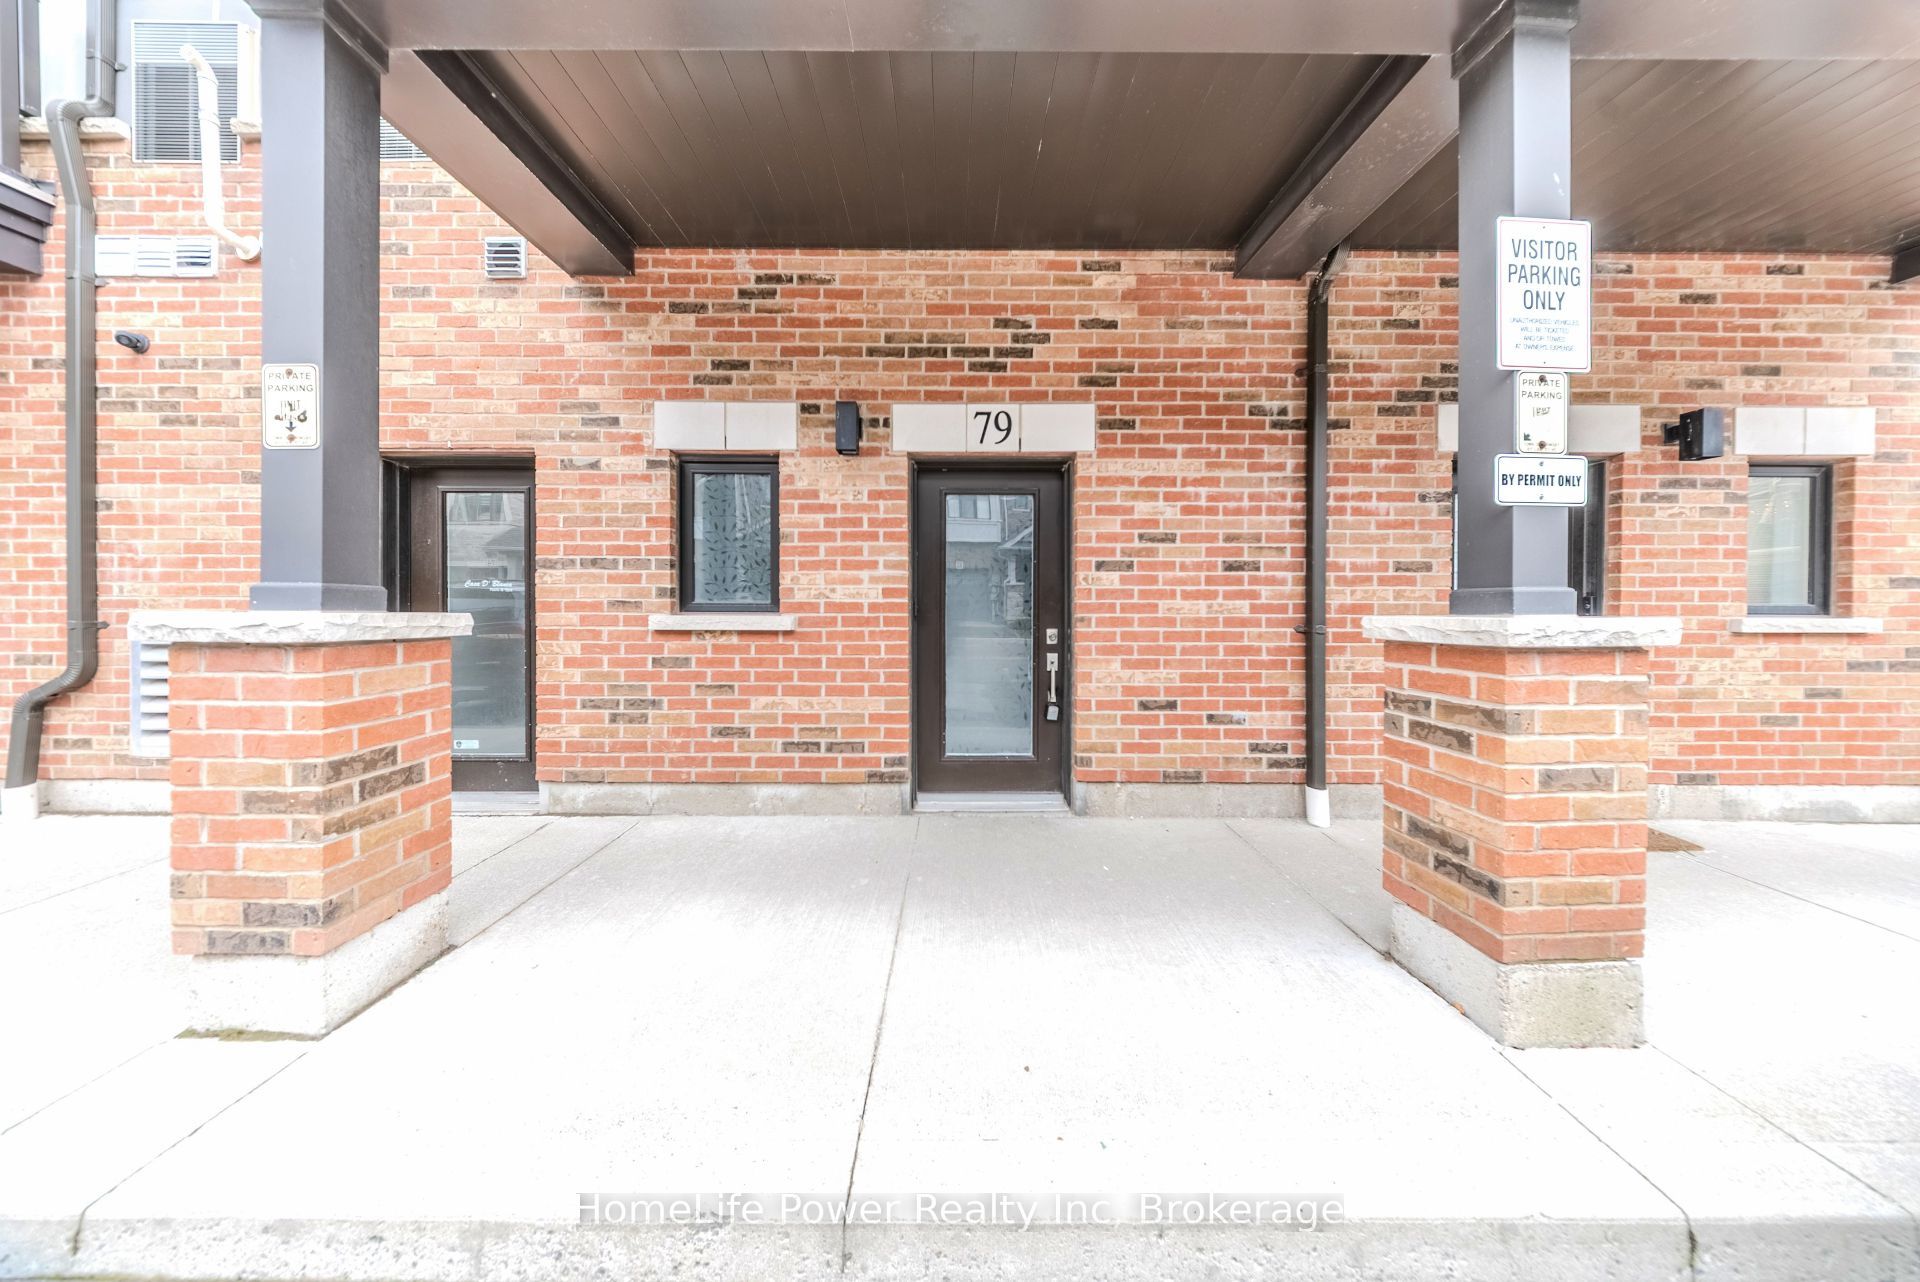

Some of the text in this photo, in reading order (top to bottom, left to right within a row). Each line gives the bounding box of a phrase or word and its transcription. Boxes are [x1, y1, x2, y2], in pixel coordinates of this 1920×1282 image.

[1511, 238, 1578, 261] VISITOR
[1507, 263, 1581, 287] PARKING
[1523, 289, 1566, 311] ONLY
[267, 384, 314, 392] PARKING
[1522, 379, 1561, 388] PRIVATE
[1521, 391, 1562, 400] PARKING
[973, 410, 1012, 445] 79
[1501, 473, 1582, 487] BY PERMIT ONLY
